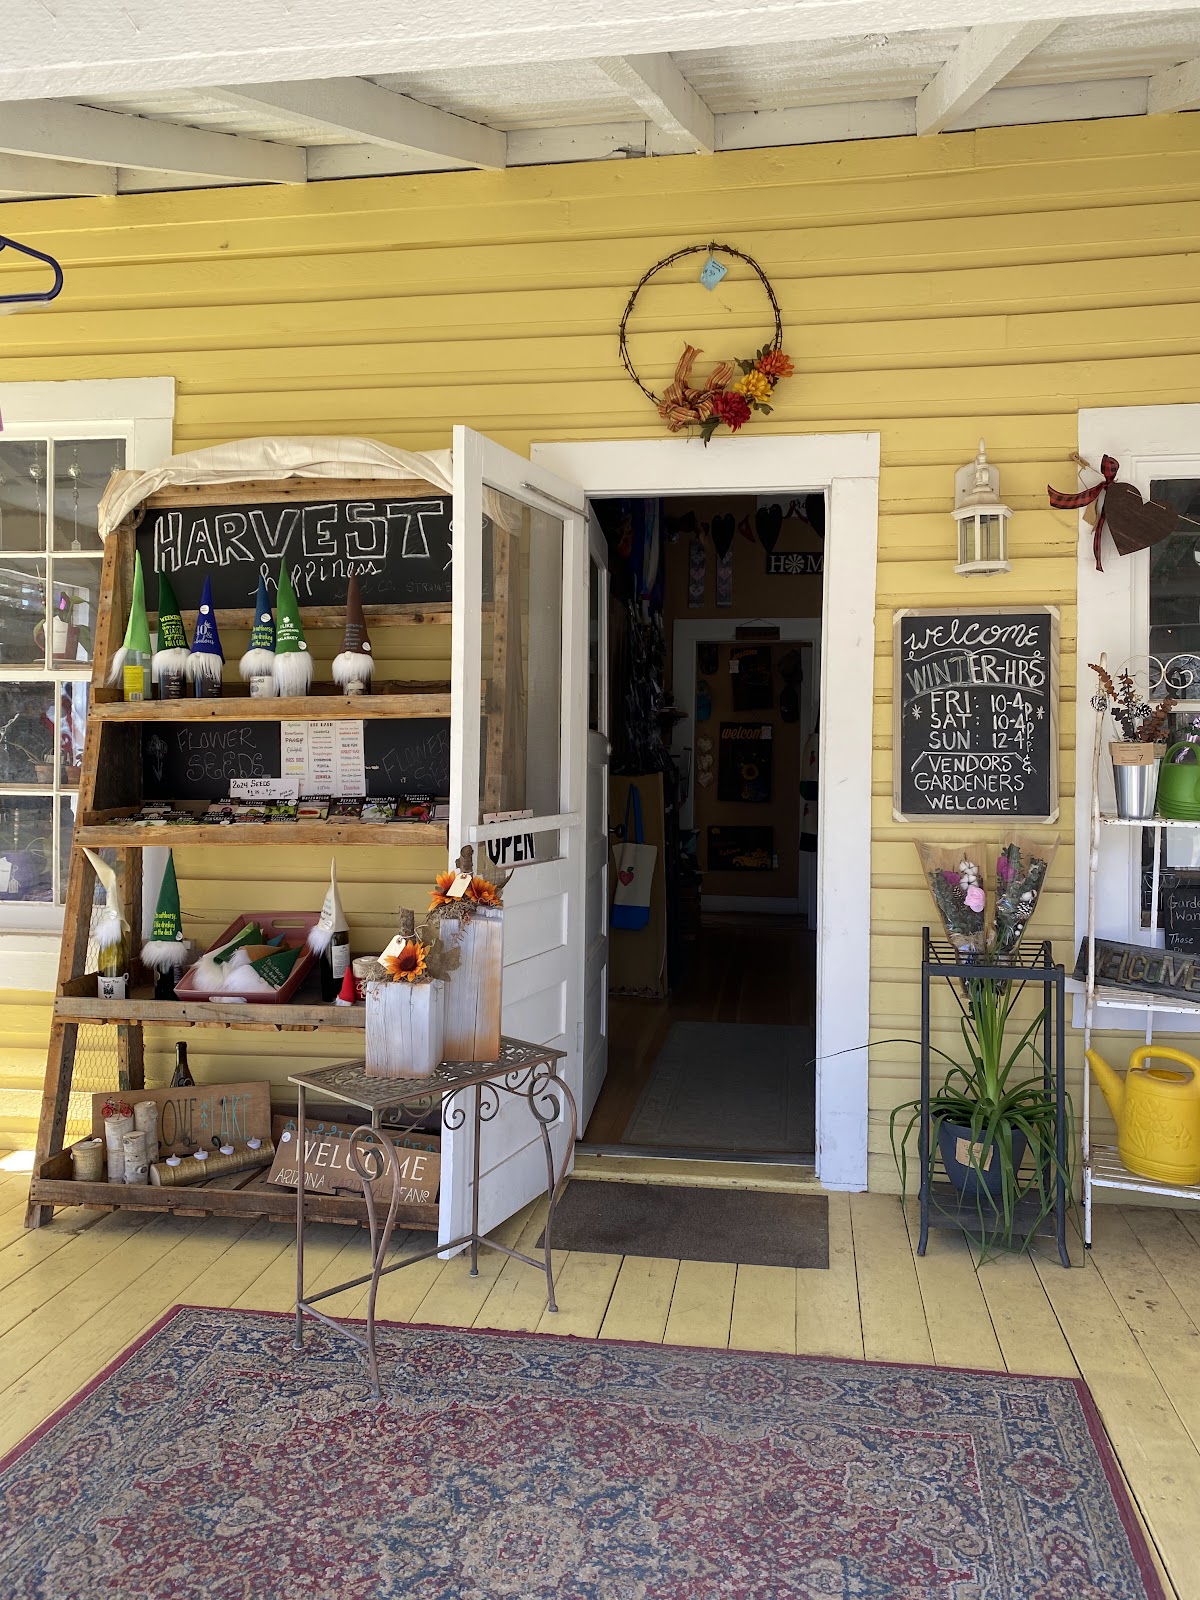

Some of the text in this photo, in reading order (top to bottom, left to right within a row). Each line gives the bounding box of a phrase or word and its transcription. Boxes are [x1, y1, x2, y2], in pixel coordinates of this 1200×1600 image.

[153, 500, 444, 573] HARVEST
[769, 554, 824, 574] HOM
[247, 557, 383, 597] hppiness
[904, 618, 1040, 650] welcome
[177, 727, 257, 752] FLOWER
[721, 726, 763, 739] welcom
[186, 750, 265, 781] SEEDS
[929, 755, 1013, 773] VENDORS
[232, 779, 271, 789] 2024 SEEDS
[914, 772, 1025, 793] GARDENERS
[925, 794, 1019, 811] WELCOME!
[1168, 933, 1194, 945] Those
[162, 1098, 198, 1147] OVE
[295, 1138, 428, 1181] WELCOME
